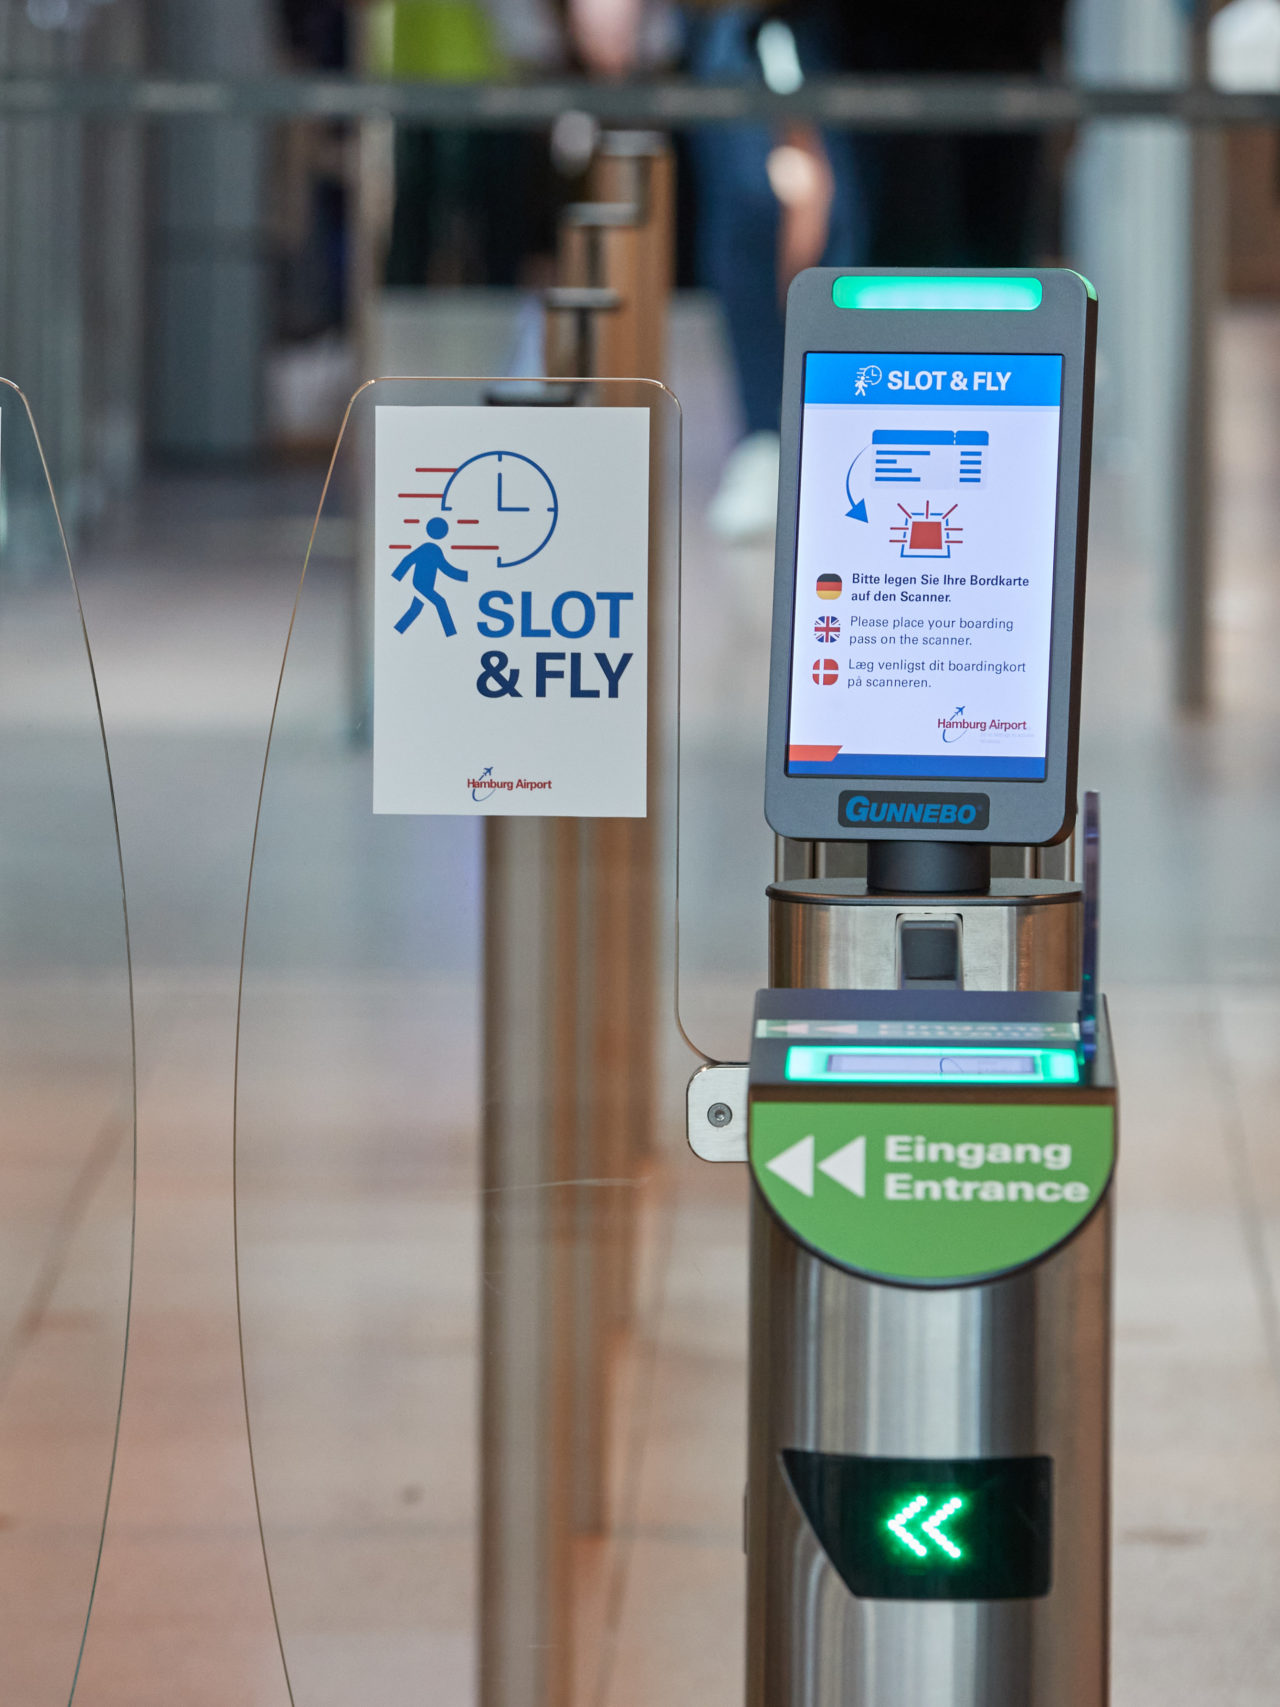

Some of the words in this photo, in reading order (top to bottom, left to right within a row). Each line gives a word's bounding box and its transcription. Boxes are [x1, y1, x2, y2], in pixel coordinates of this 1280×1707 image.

[887, 370, 947, 390] SLOT
[950, 372, 968, 391] &
[973, 372, 1012, 391] FLY
[851, 573, 880, 584] Bitte
[884, 573, 917, 588] legen
[921, 574, 940, 585] Sie
[943, 574, 966, 586] Ihre
[970, 574, 1030, 587] Bordkarte
[851, 590, 870, 601] auf
[873, 591, 897, 602] den
[900, 592, 952, 603] Scanner.
[477, 590, 634, 639] SLOT
[850, 616, 889, 628] Please
[892, 617, 924, 632] place
[928, 619, 956, 632] your
[959, 618, 1014, 632] boarding
[849, 634, 877, 646] pass
[880, 635, 896, 645] on
[899, 634, 919, 645] the
[922, 636, 972, 646] scanner.
[476, 650, 523, 699] &
[535, 652, 634, 699] FLY
[848, 659, 874, 672] Læg
[878, 660, 926, 673] venligst
[929, 660, 945, 672] dit
[948, 660, 1027, 675] boardingkort
[847, 675, 862, 688] på
[866, 678, 932, 688] scanneren.
[937, 718, 987, 731] Hamburg
[989, 719, 1027, 732] Airport
[467, 779, 514, 791] Hamburg
[516, 779, 552, 791] Airport
[845, 795, 977, 824] GUNNEBO
[884, 1136, 1072, 1170] Eingang
[884, 1173, 1091, 1203] Entrance
